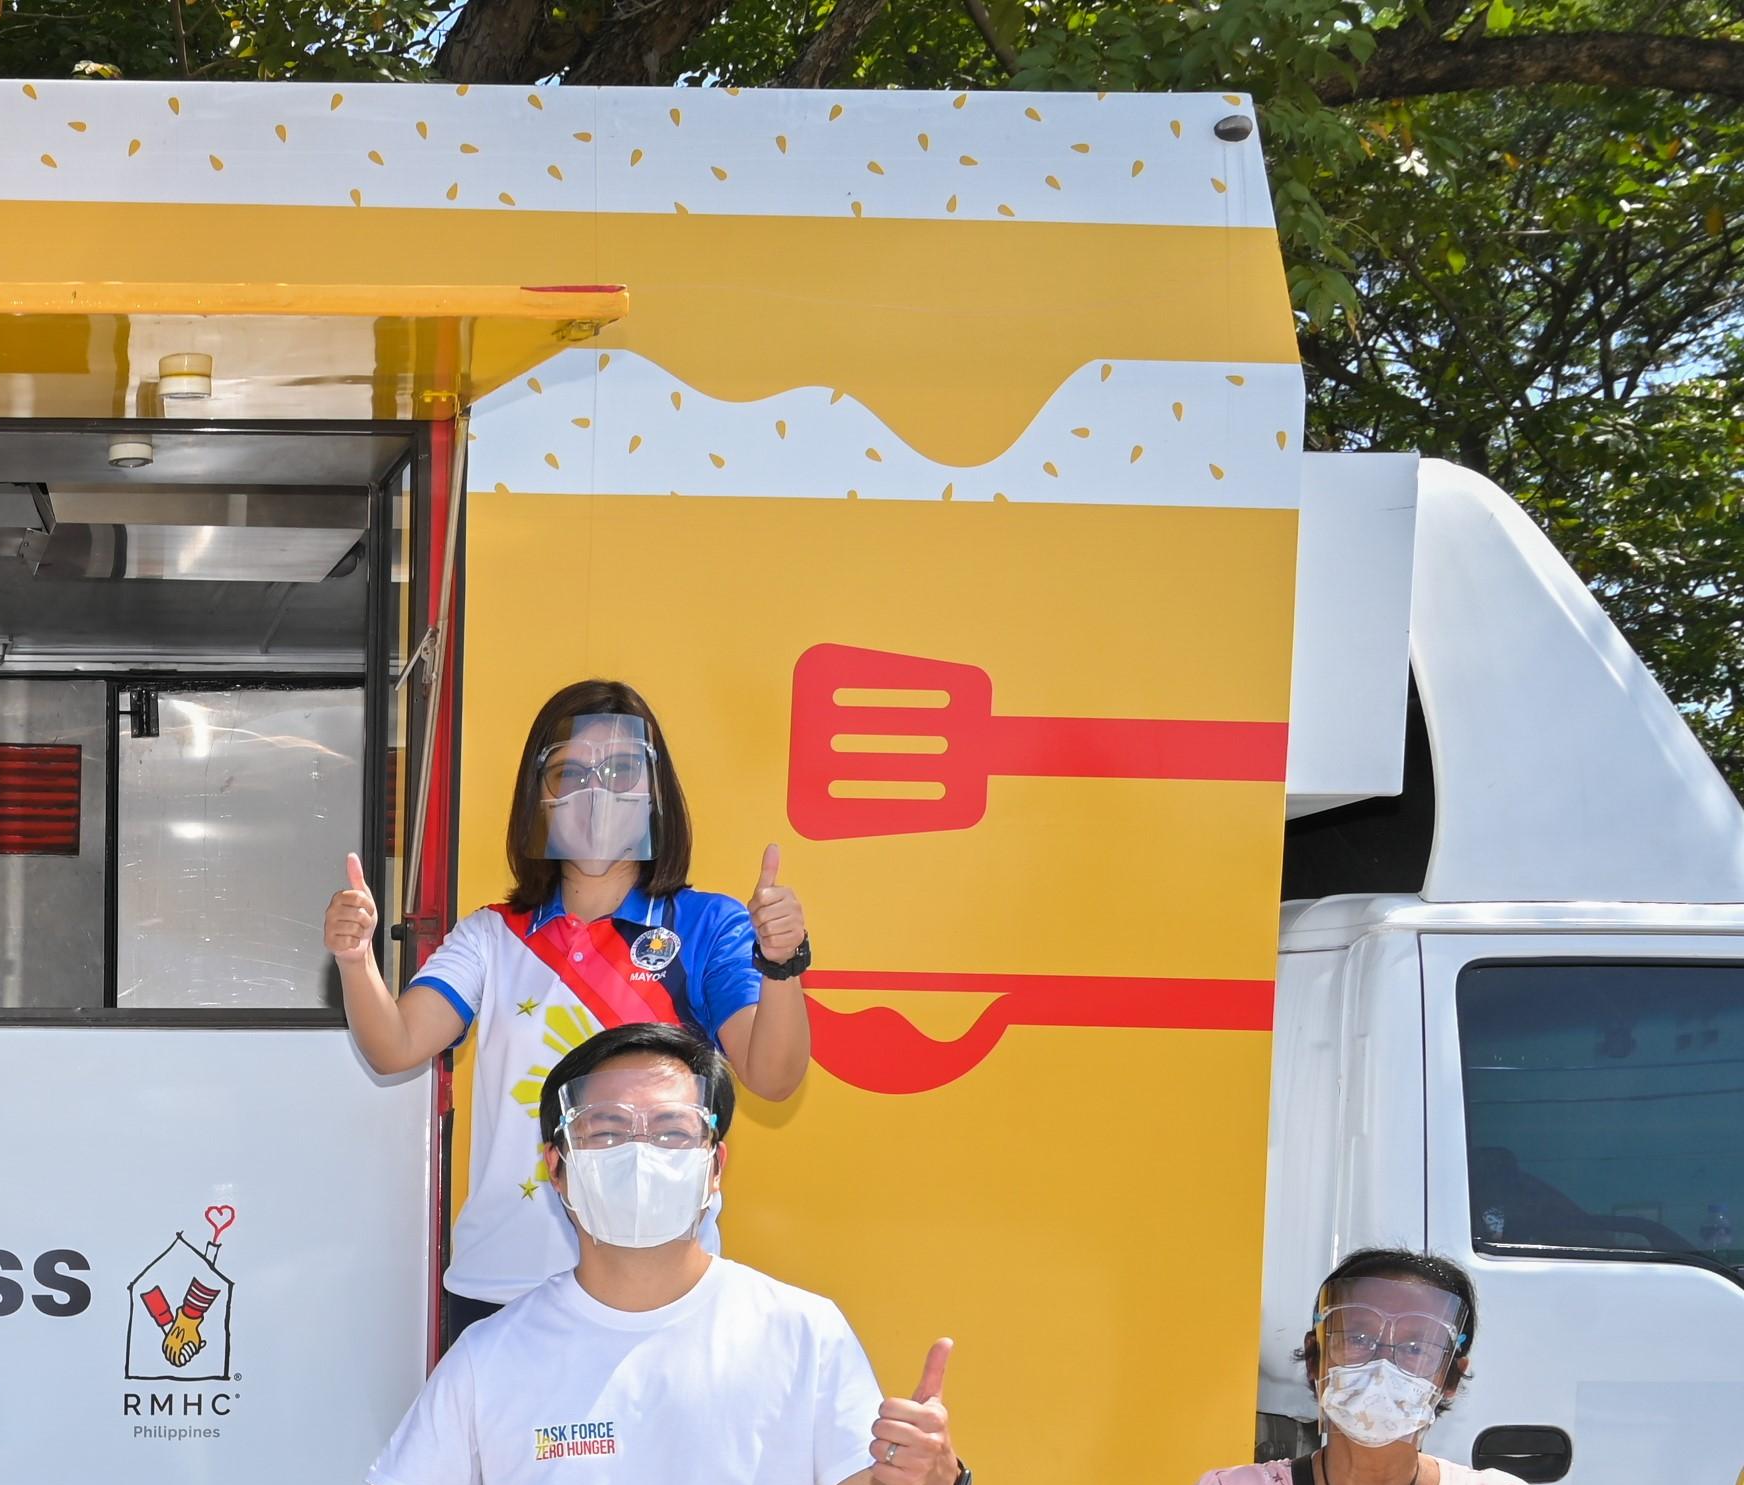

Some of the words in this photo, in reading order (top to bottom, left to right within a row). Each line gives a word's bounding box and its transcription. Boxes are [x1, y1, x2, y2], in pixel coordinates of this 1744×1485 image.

[629, 970, 667, 982] MAYOR
[123, 1393, 231, 1416] RMHC
[133, 1425, 221, 1441] Philippines
[535, 1425, 568, 1445] TASK
[571, 1421, 615, 1440] FORCE
[536, 1442, 564, 1461] ZERO
[567, 1439, 616, 1457] HUNGER
